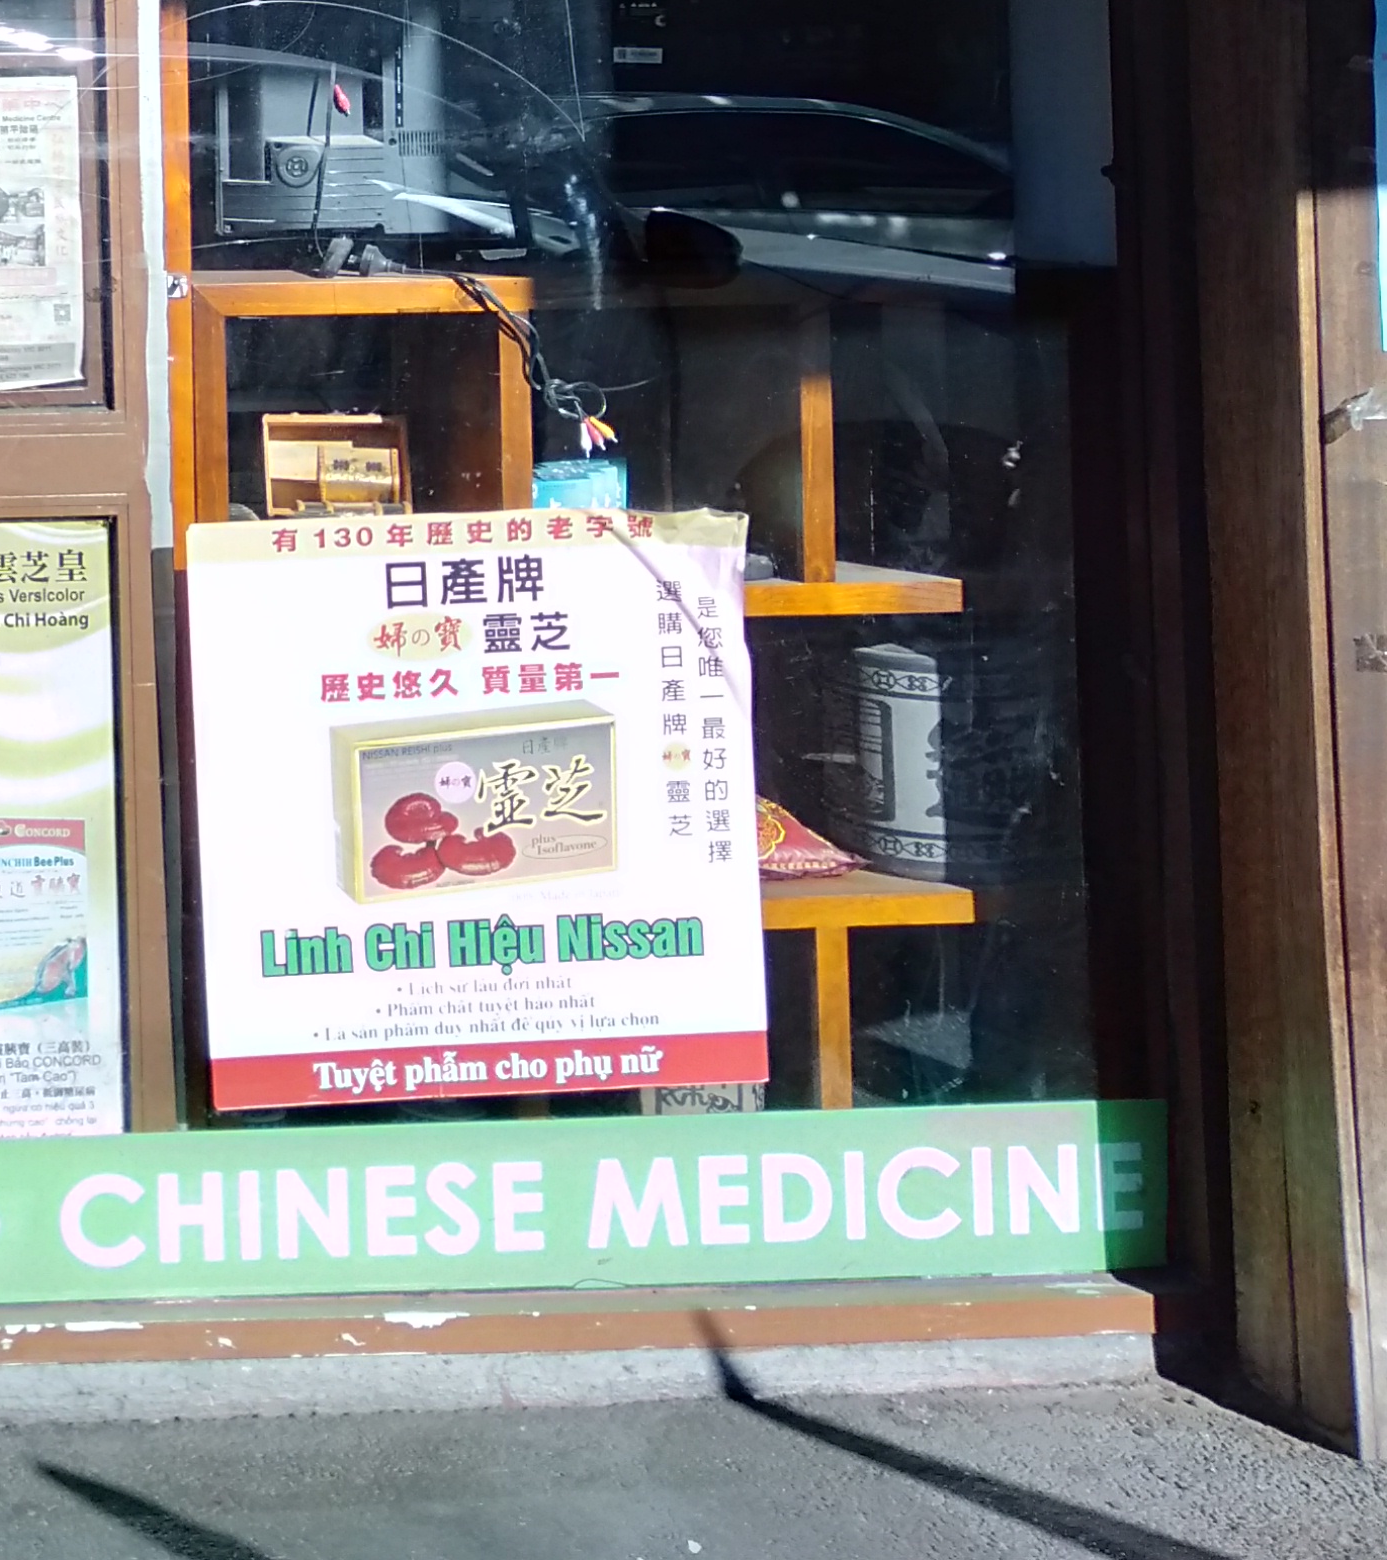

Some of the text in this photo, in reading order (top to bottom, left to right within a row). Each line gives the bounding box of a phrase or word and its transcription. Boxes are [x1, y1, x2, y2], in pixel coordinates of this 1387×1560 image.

[272, 514, 655, 553] 有130年歷史的老字號
[9, 588, 85, 603] Versicolor
[385, 554, 545, 610] 日產牌
[4, 613, 30, 628] Chi
[35, 611, 89, 631] Hoàng
[482, 610, 572, 655] 靈芝
[656, 580, 687, 736] 選購日產牌
[320, 661, 621, 704] 歷史悠久 質量第一
[697, 596, 733, 864] 是您唯一最好的選擇
[362, 747, 400, 762] NISSAN
[474, 756, 608, 835] 靈芝
[666, 780, 693, 837] 靈芝
[14, 824, 70, 838] CONCORD
[531, 834, 556, 849] plus
[536, 838, 598, 856] Isoflavone
[260, 913, 705, 978] Linh Chi Hiệu Nissan
[32, 1054, 101, 1068] CONCORD
[313, 1044, 664, 1095] Tuyệt phẩm cho phụ nữ
[58, 1160, 547, 1269] CHINESE
[587, 1140, 1145, 1251] MEDICINE
